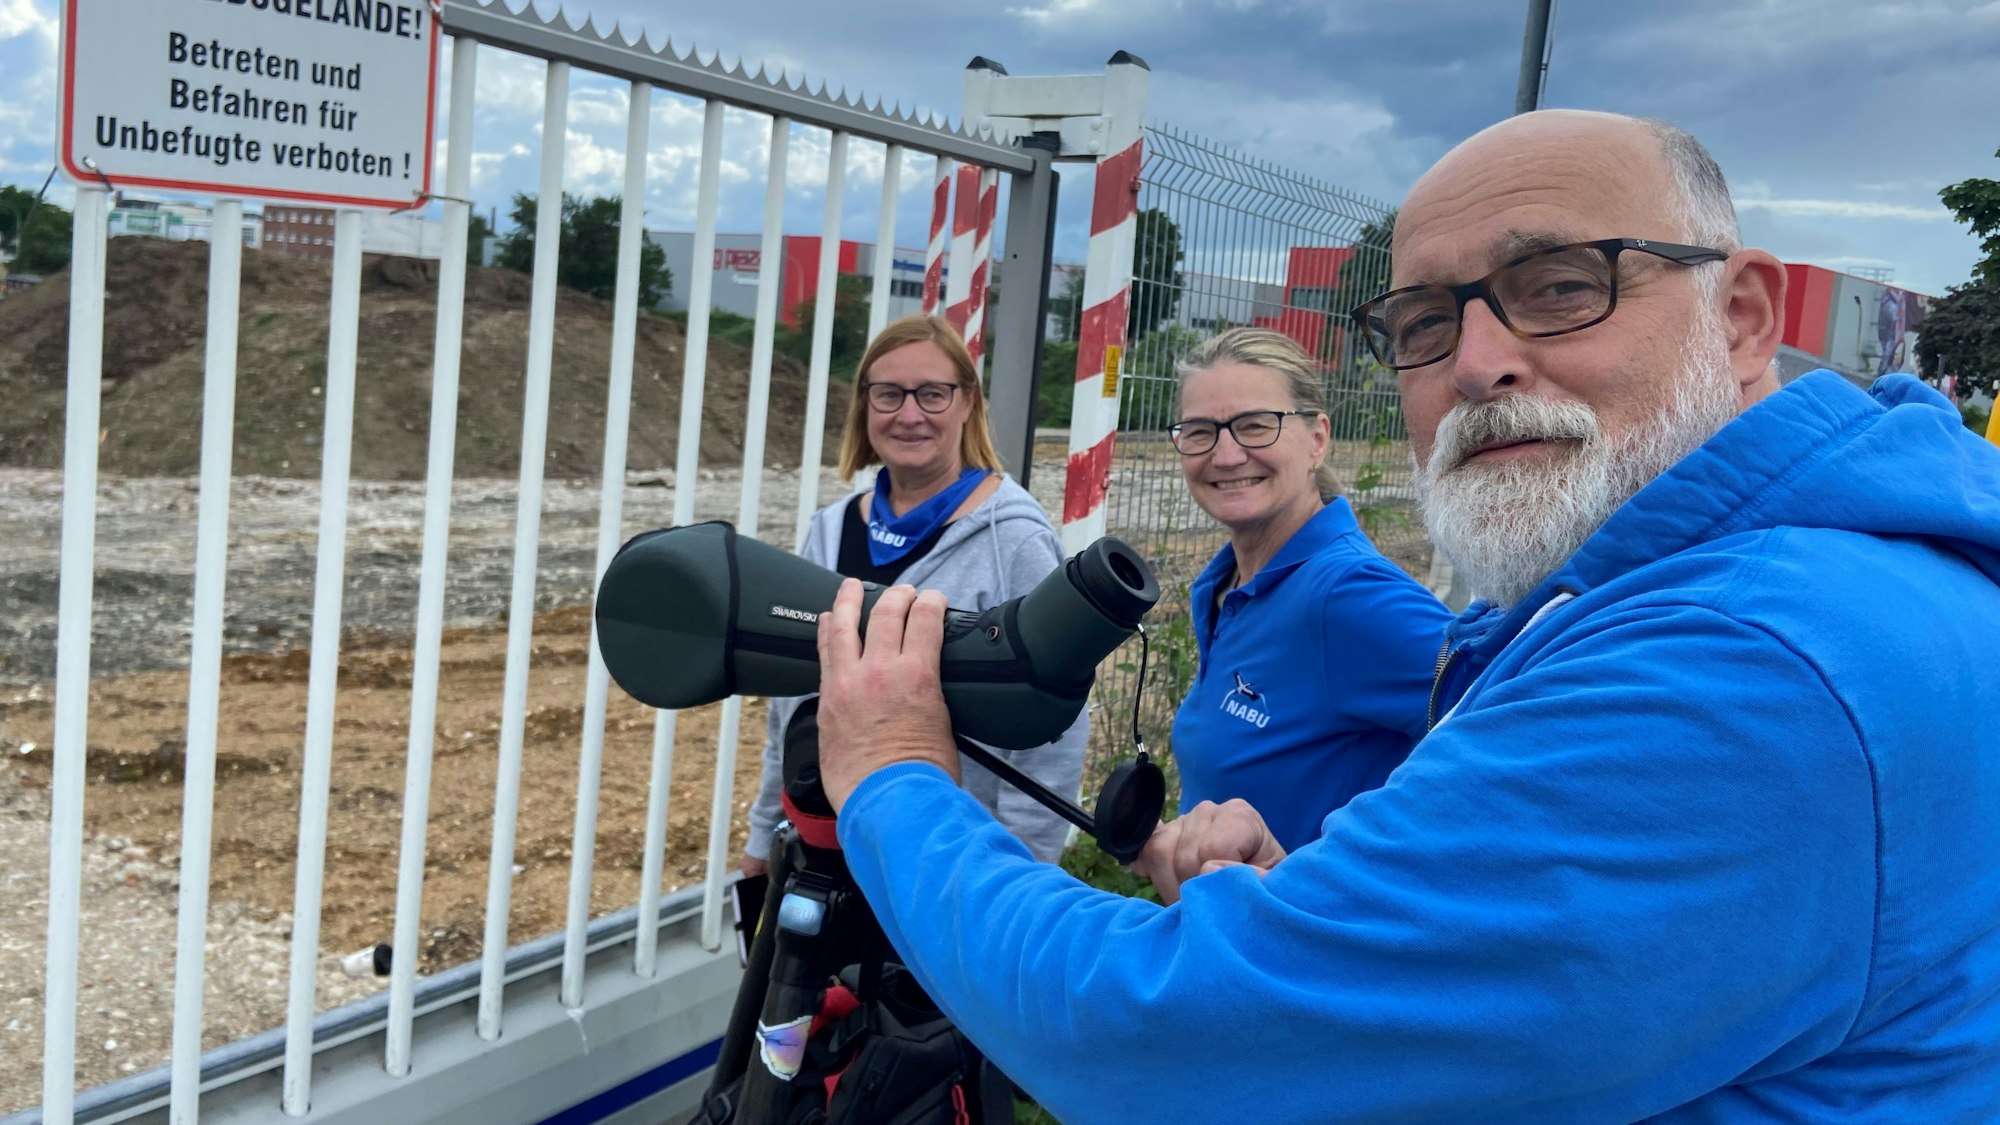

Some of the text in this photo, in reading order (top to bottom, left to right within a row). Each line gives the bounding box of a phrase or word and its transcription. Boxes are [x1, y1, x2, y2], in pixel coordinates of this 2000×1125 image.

[168, 31, 361, 91] Betreten und
[170, 78, 358, 132] Befahren für
[96, 115, 411, 179] Unbefugte verboten !
[871, 528, 907, 548] NABU
[772, 605, 818, 622] SWAROVSKI
[1225, 699, 1271, 728] NABU
